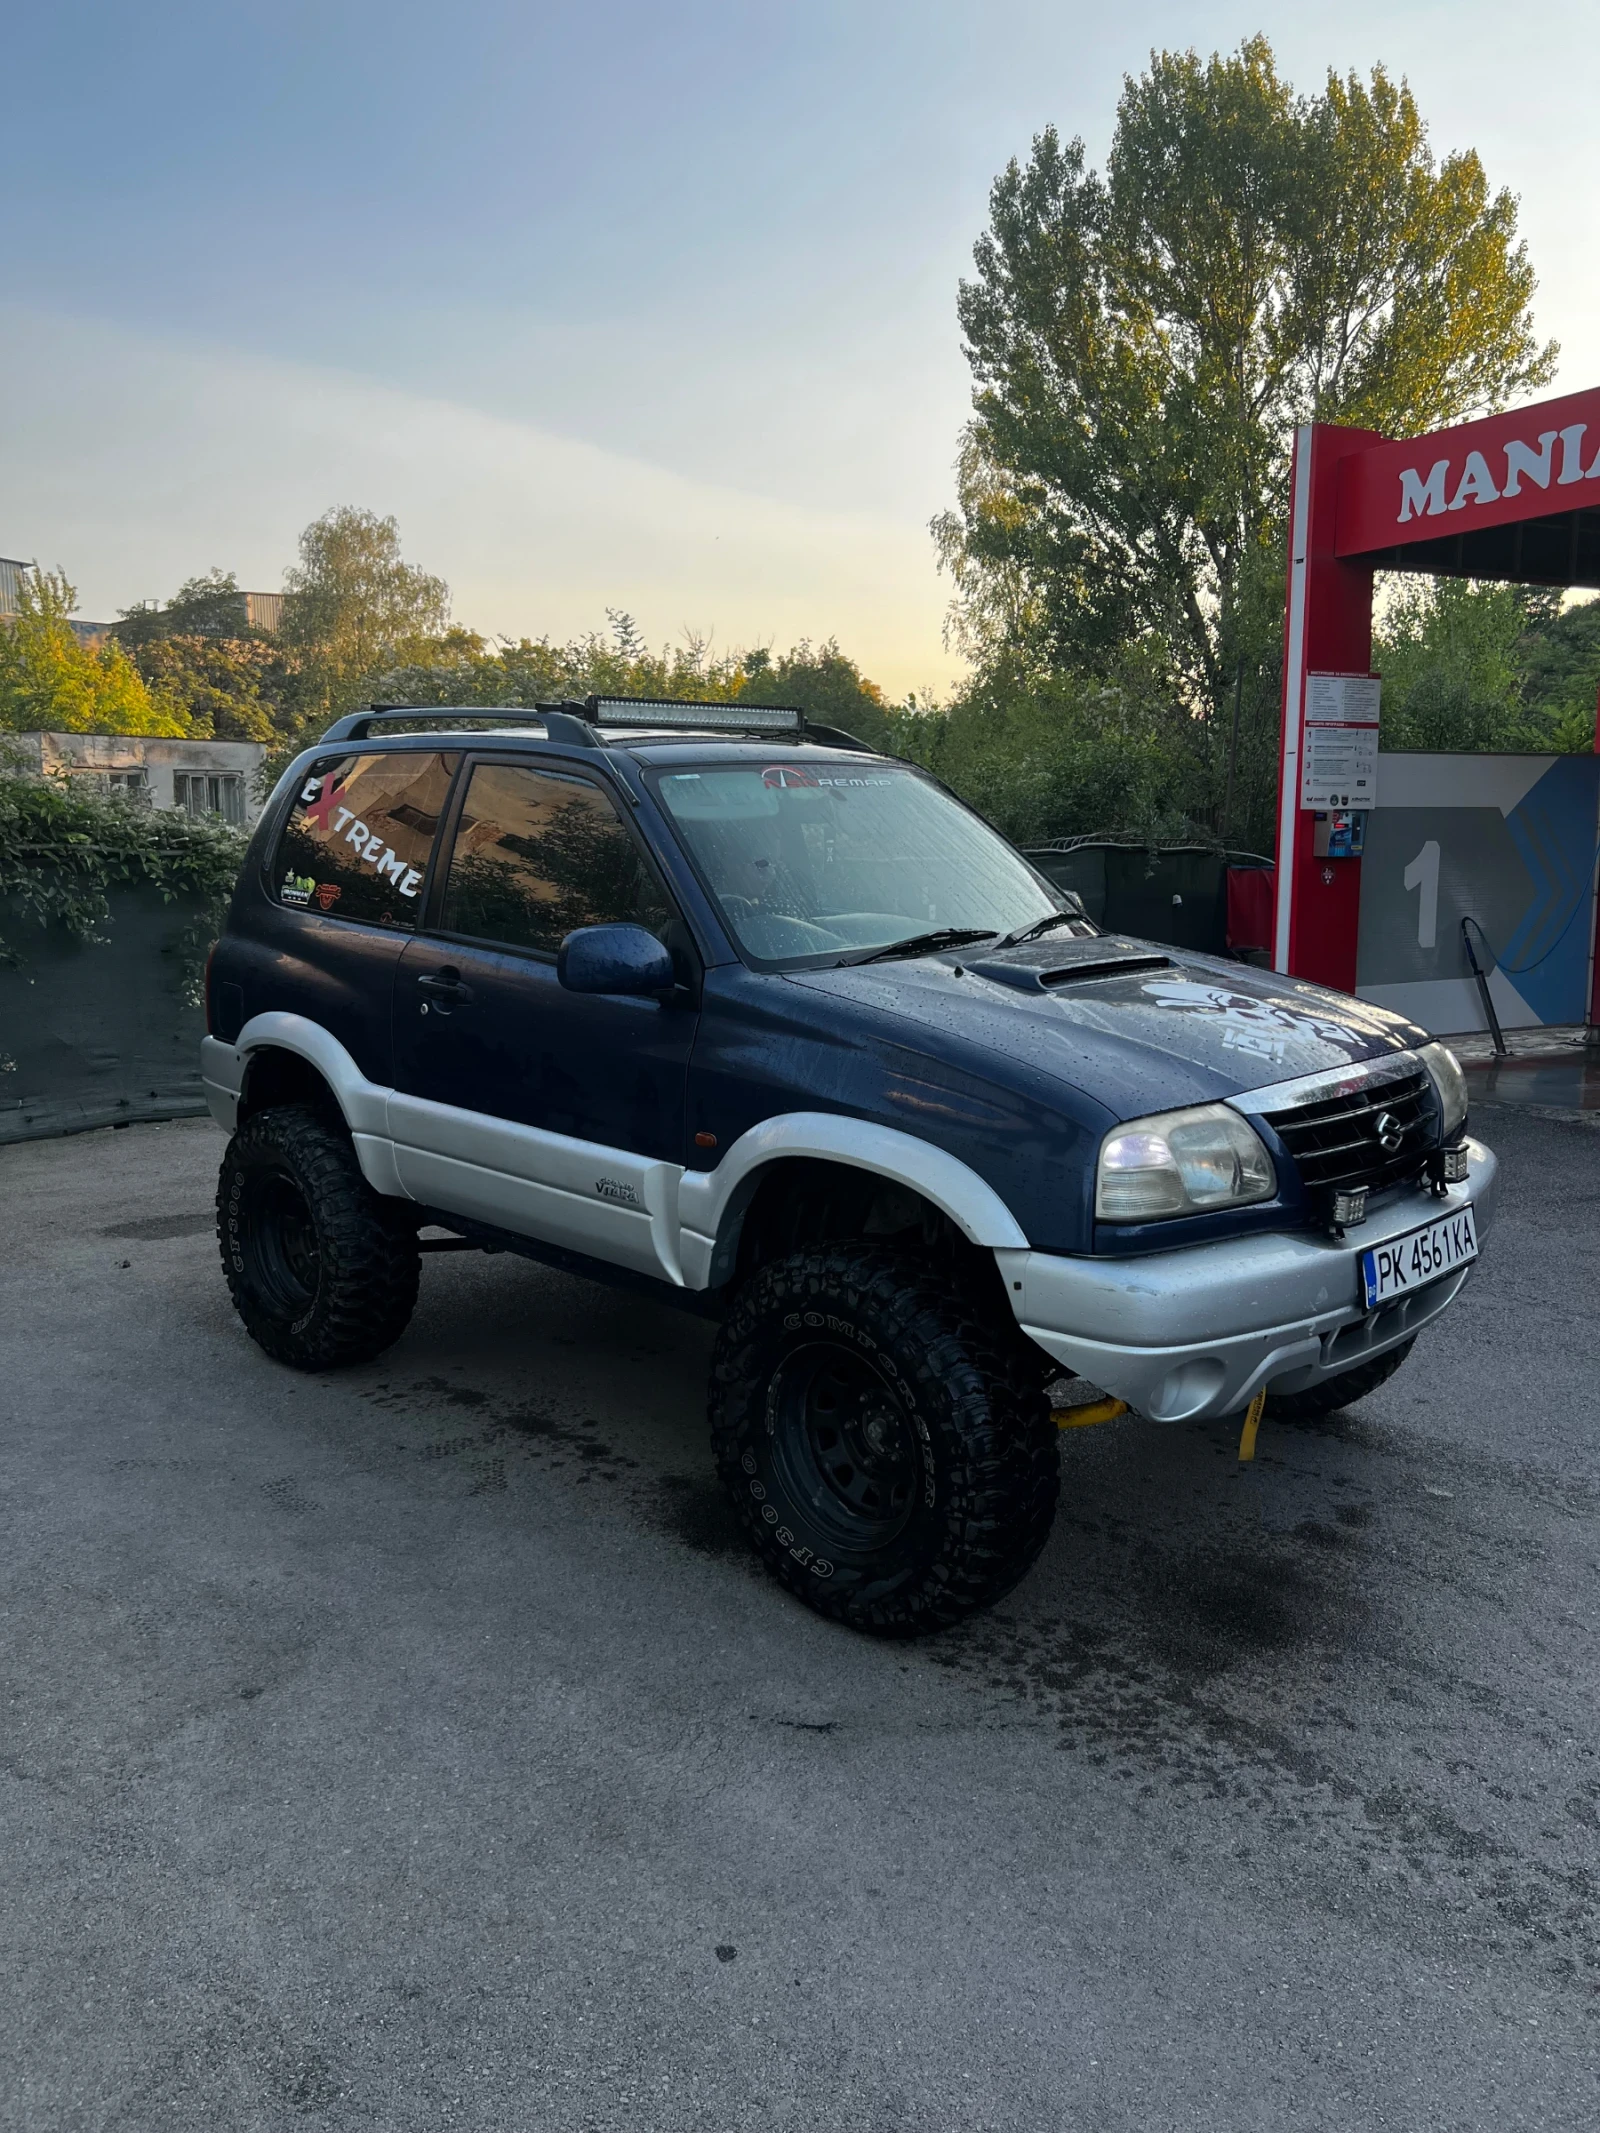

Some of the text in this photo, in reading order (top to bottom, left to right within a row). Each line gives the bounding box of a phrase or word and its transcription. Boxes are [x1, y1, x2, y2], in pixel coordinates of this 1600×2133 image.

[301, 772, 423, 897] EXTREME
[1404, 840, 1440, 948] 1
[595, 1181, 640, 1204] VITARA
[600, 1177, 635, 1191] GRAND
[1378, 1245, 1407, 1293] PK
[741, 1453, 834, 1578] CF3000
